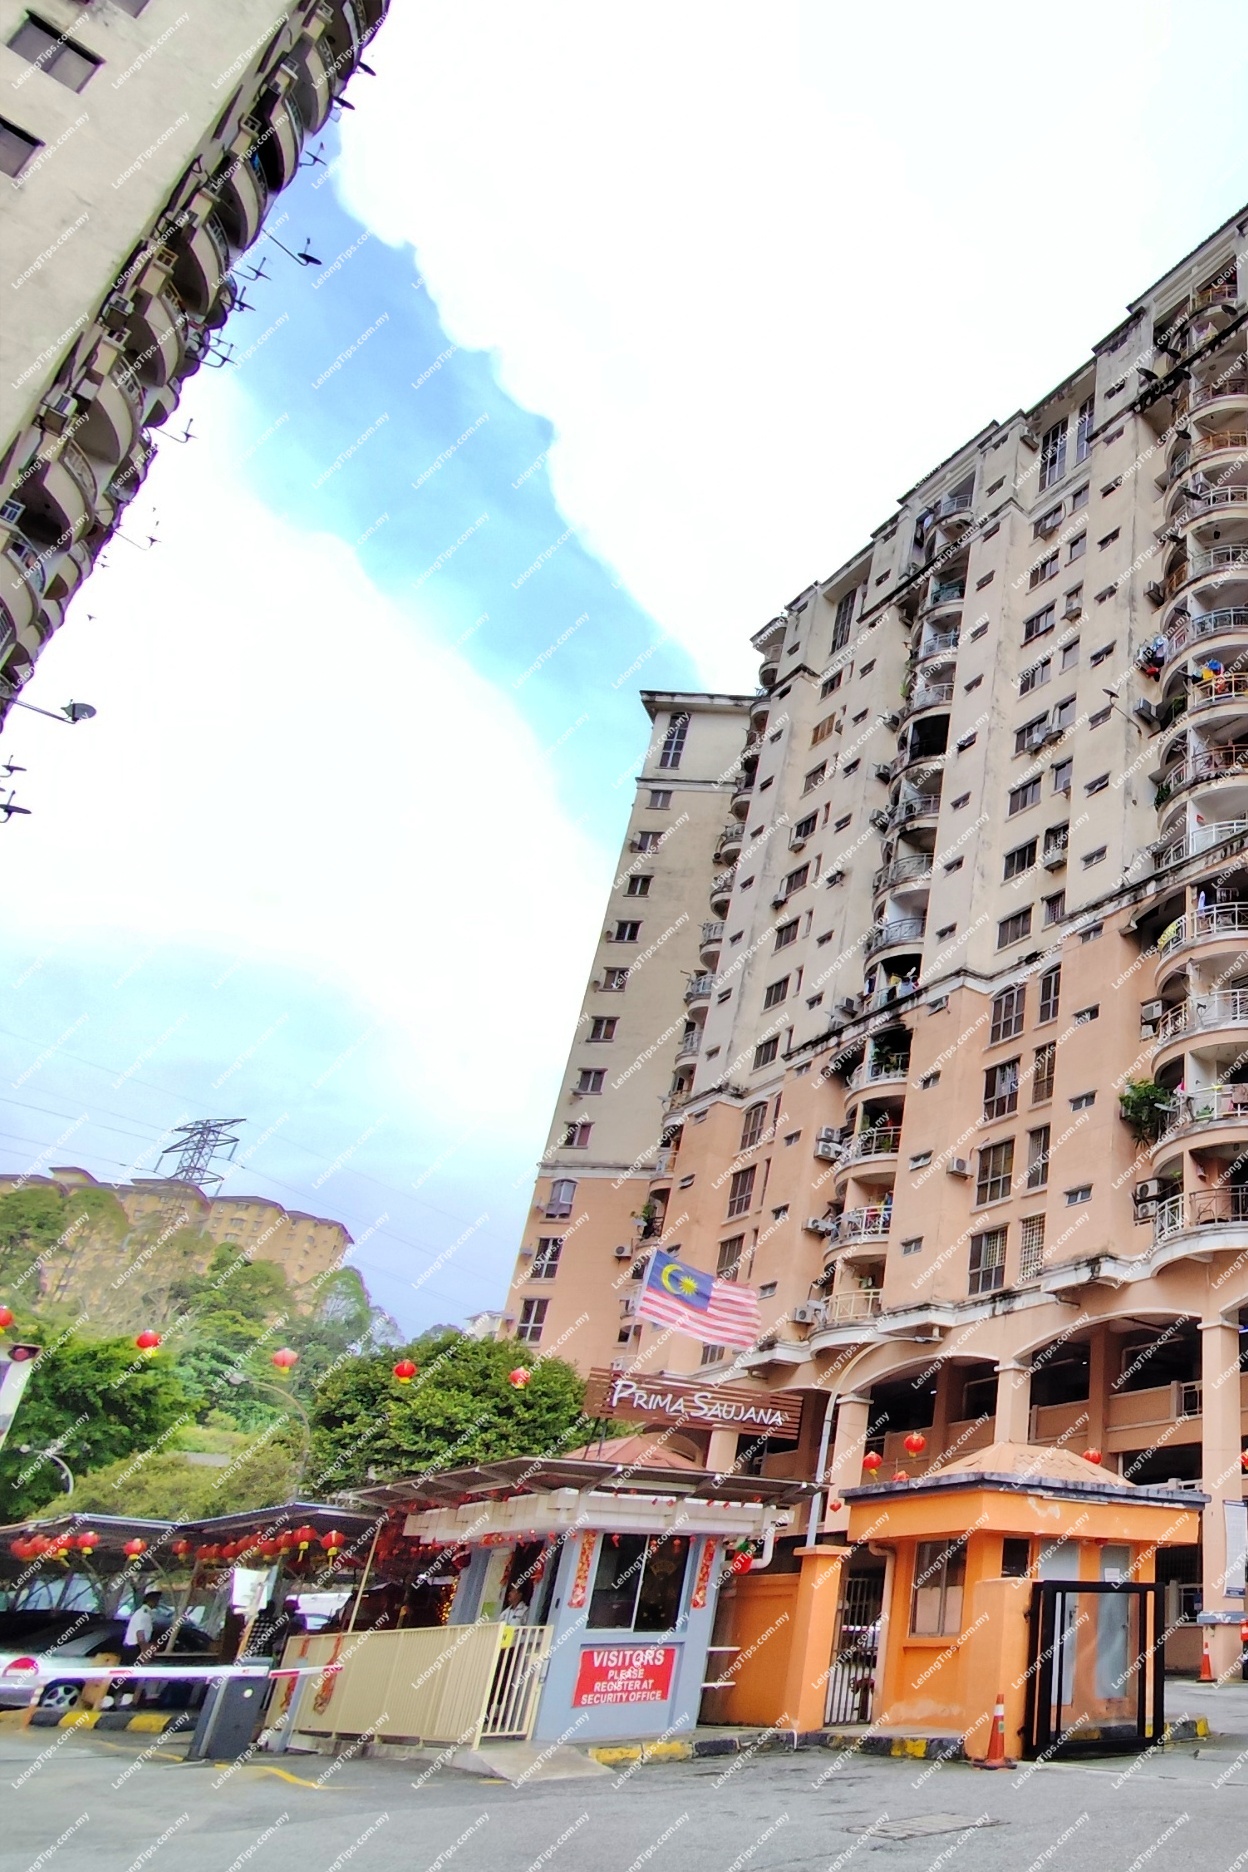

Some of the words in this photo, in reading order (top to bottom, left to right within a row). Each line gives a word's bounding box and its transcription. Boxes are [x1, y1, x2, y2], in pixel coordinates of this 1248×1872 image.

[611, 1380, 685, 1414] PRIMA
[690, 1392, 783, 1426] SAUJANA
[593, 1649, 665, 1667] VISITORS
[608, 1669, 645, 1679] PLEASE
[594, 1681, 643, 1692] REGISTER
[642, 1679, 654, 1689] AT
[581, 1693, 628, 1705] SECURITY
[629, 1690, 662, 1702] OFFICE
